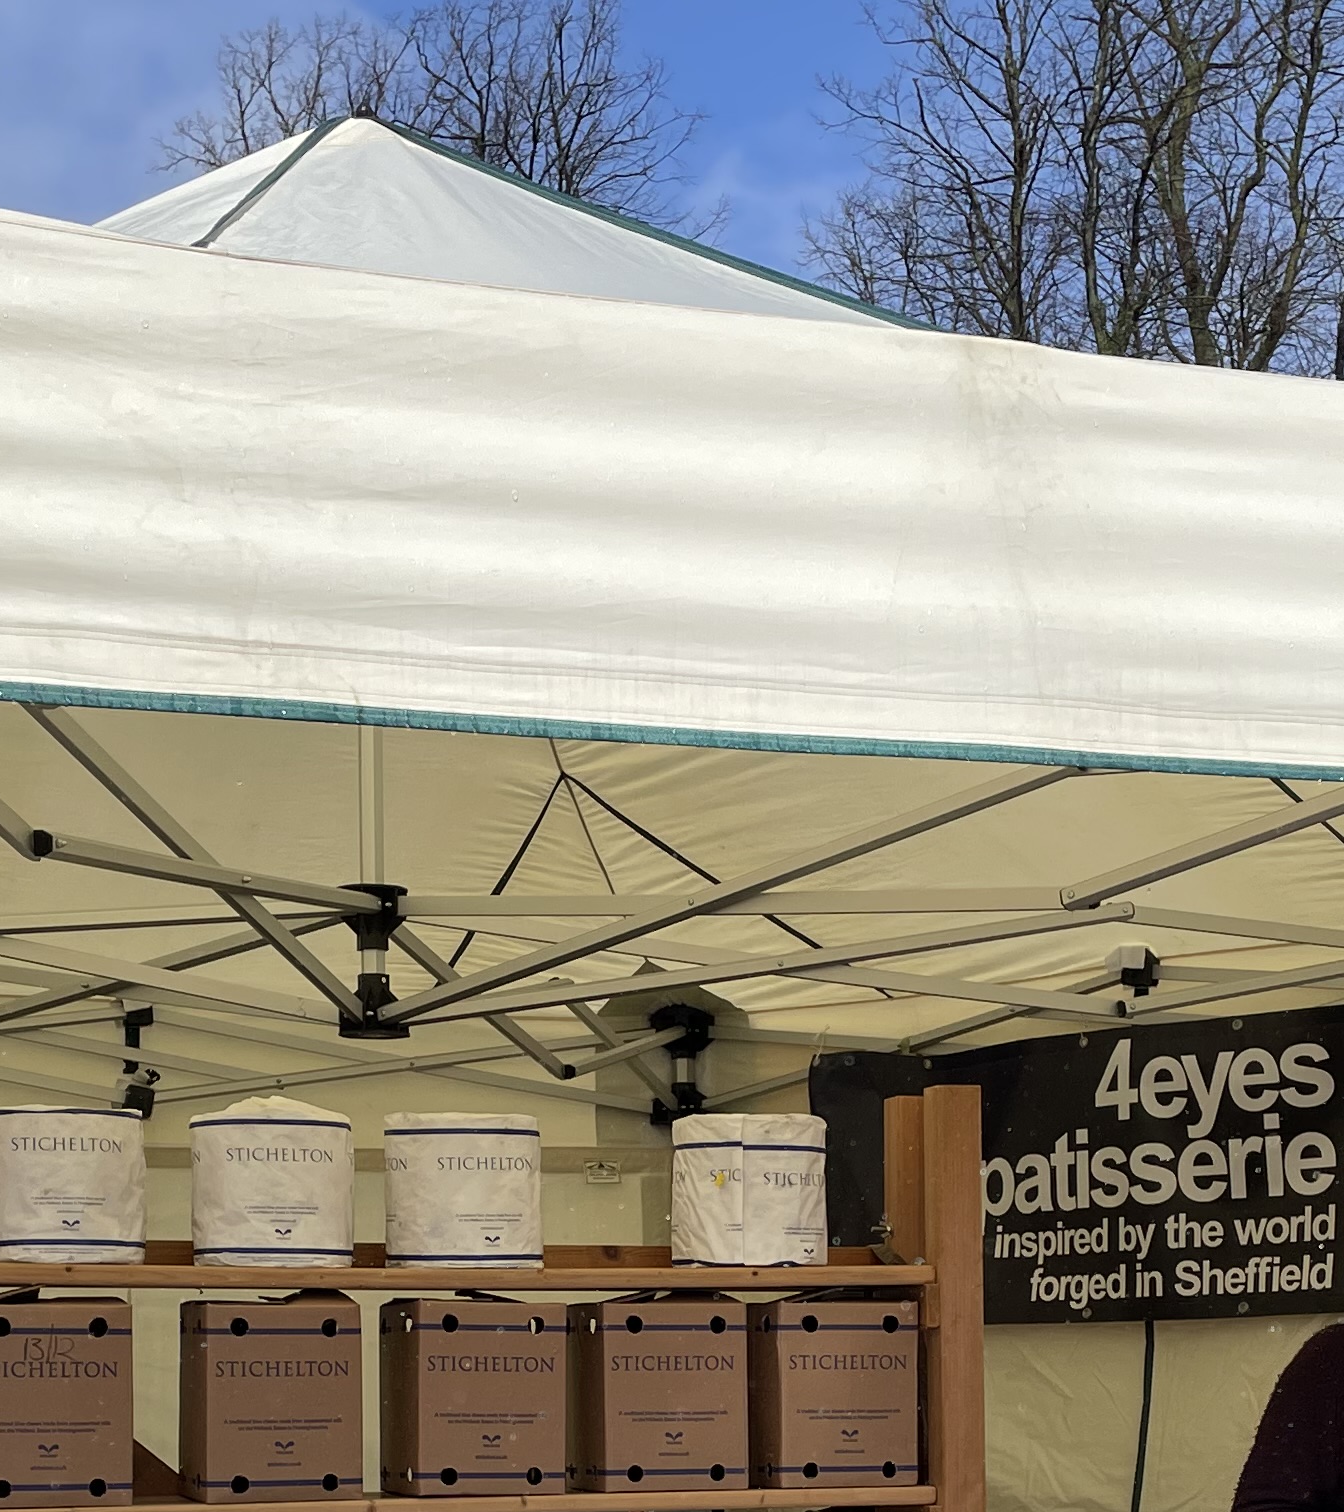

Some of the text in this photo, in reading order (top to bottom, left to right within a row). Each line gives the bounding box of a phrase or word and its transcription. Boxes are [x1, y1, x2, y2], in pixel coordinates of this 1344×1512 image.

[1094, 1038, 1335, 1139] 4eyes
[10, 1136, 123, 1154] STICHELTON
[226, 1147, 334, 1164] STICHELTON
[437, 1156, 533, 1171] STICHELTON
[981, 1113, 1338, 1236] patisserie
[993, 1203, 1337, 1265] inspired by the world
[1030, 1253, 1335, 1310] forged in Sheffield
[215, 1360, 350, 1378] STICHELTON
[427, 1355, 556, 1373] STICHELTON
[611, 1355, 735, 1372] STICHELTON
[789, 1354, 908, 1370] STICHELTON
